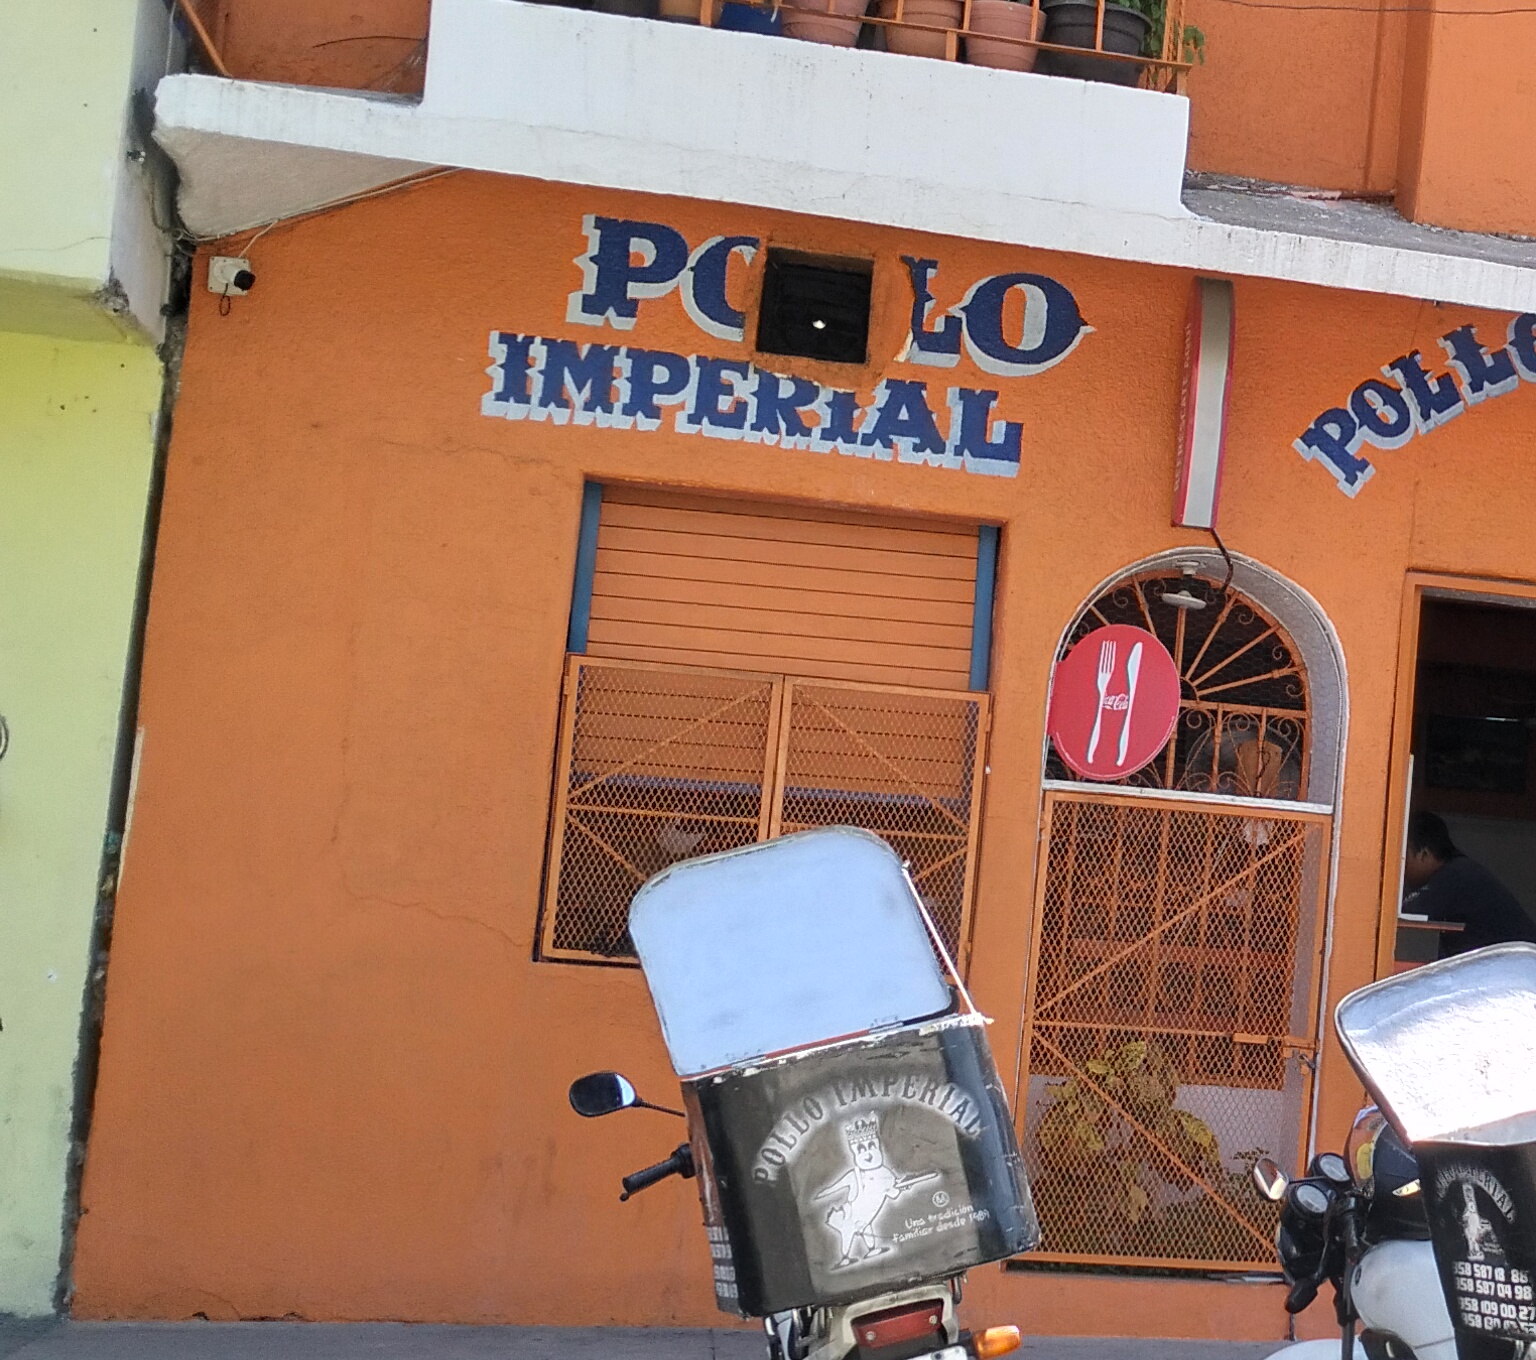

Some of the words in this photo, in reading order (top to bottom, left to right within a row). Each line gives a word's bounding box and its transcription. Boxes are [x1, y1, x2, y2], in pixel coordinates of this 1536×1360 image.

[566, 213, 1096, 377] POLO
[480, 330, 1024, 478] IMPERIAL
[753, 1095, 825, 1187] POLLO
[830, 1074, 984, 1139] IMPERIAL
[1514, 1285, 1533, 1301] 98
[1518, 1305, 1536, 1321] 27
